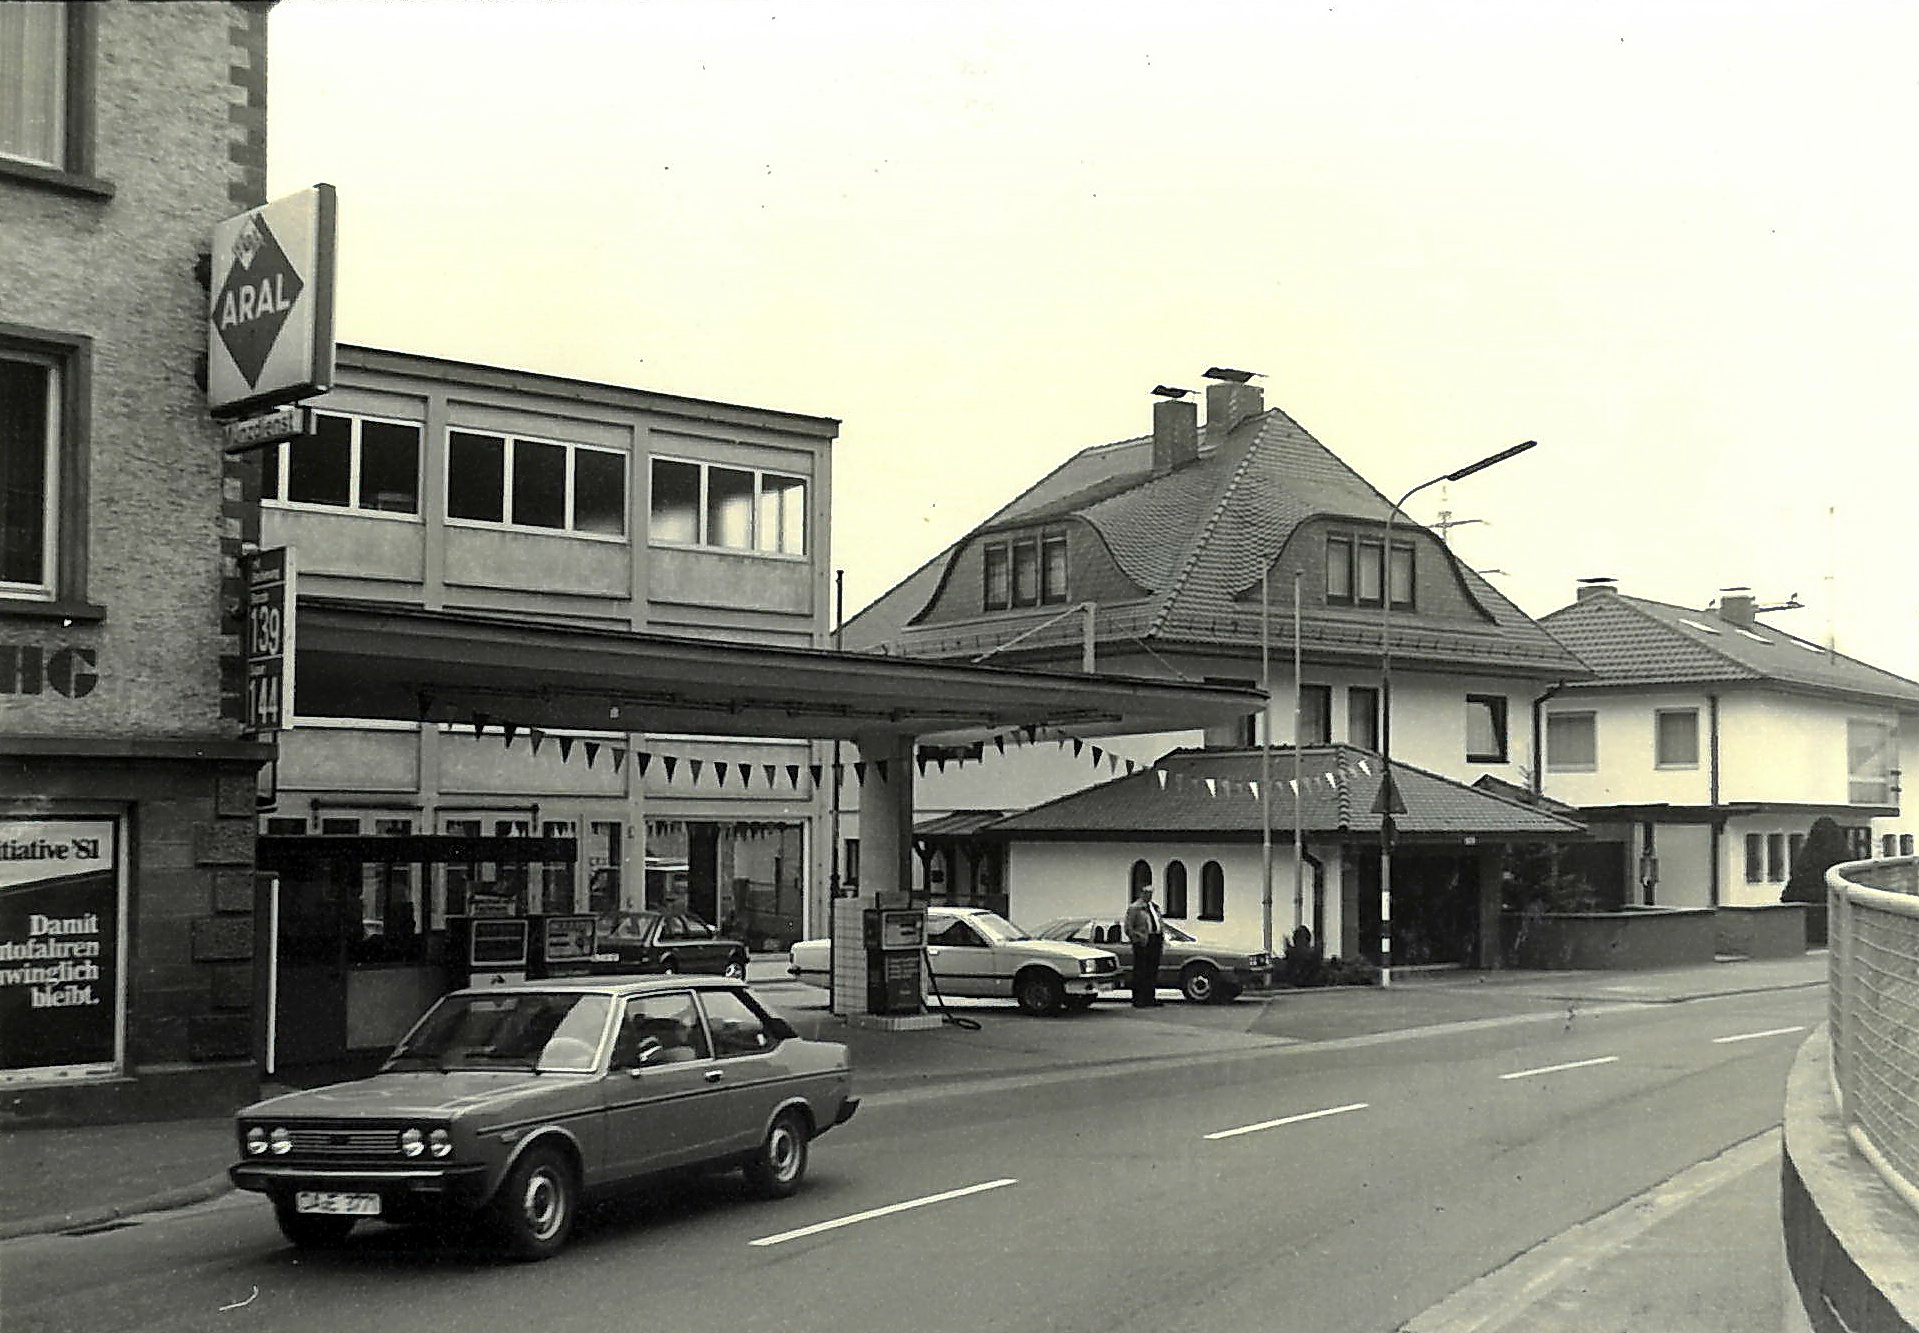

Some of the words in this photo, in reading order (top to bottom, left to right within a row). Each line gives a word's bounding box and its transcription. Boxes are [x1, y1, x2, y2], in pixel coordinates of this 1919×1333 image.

[221, 273, 291, 330] ARAL
[250, 605, 280, 656] 139
[249, 677, 279, 726] 144
[0, 839, 69, 860] tiative
[29, 912, 99, 936] Damit
[31, 984, 101, 1008] bleibt.
